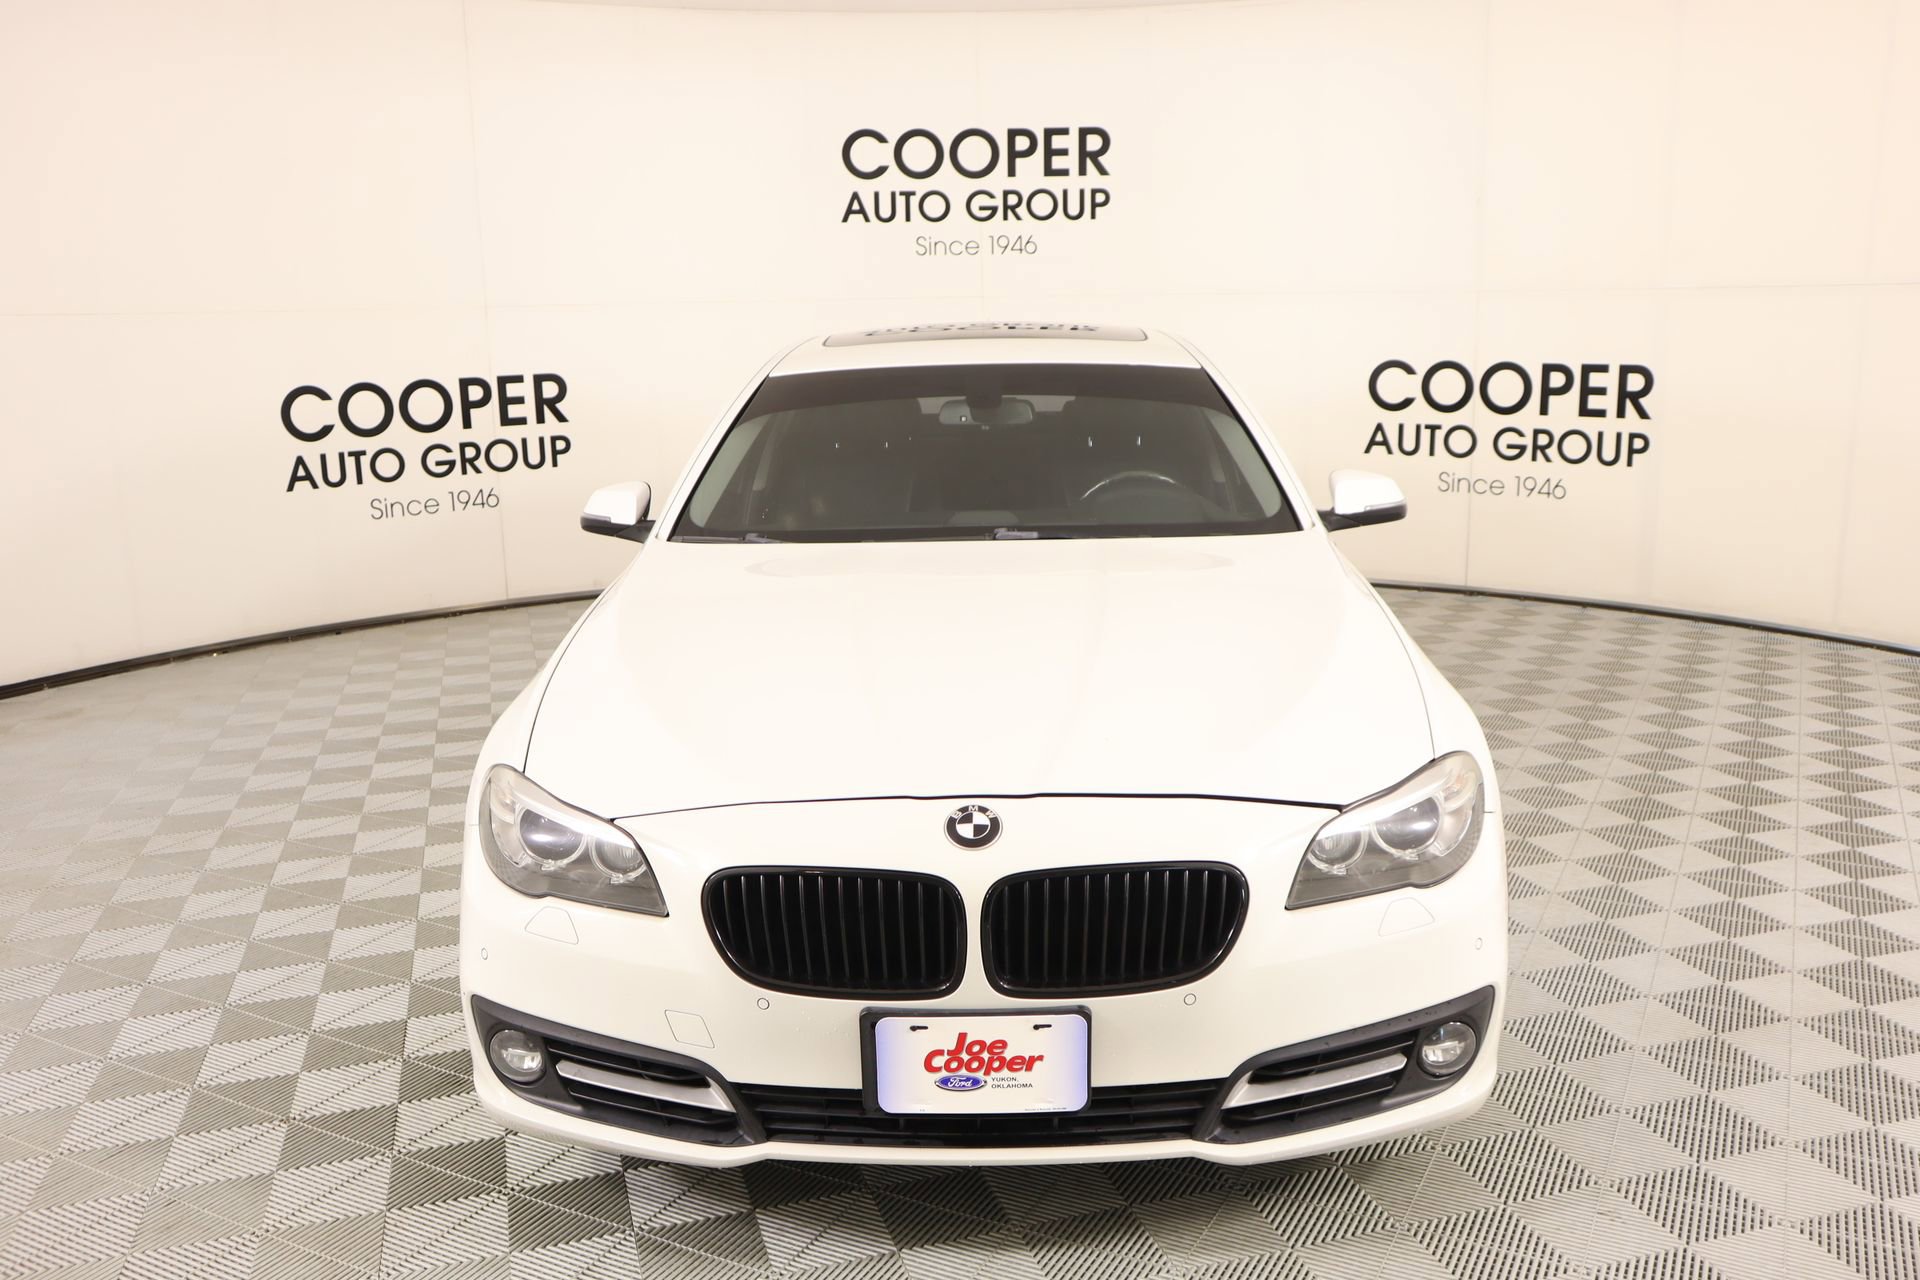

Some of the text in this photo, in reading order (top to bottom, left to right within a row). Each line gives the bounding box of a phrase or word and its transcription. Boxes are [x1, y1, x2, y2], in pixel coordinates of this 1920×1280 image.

[841, 126, 1111, 180] COOPER
[841, 188, 1111, 223] AUTO GROUP
[915, 234, 1038, 256] Since 1946
[1368, 359, 1655, 420] COOPER
[280, 373, 569, 442] COOPER
[1364, 422, 1651, 467] AUTO GROUP
[286, 434, 572, 492] AUTO GROUP
[1437, 471, 1567, 500] Since 1946
[370, 487, 500, 520] Since 1946
[950, 805, 998, 819] BMW
[946, 1032, 1008, 1056] Joe
[923, 1049, 1044, 1076] Cooper
[947, 1077, 973, 1087] Ford
